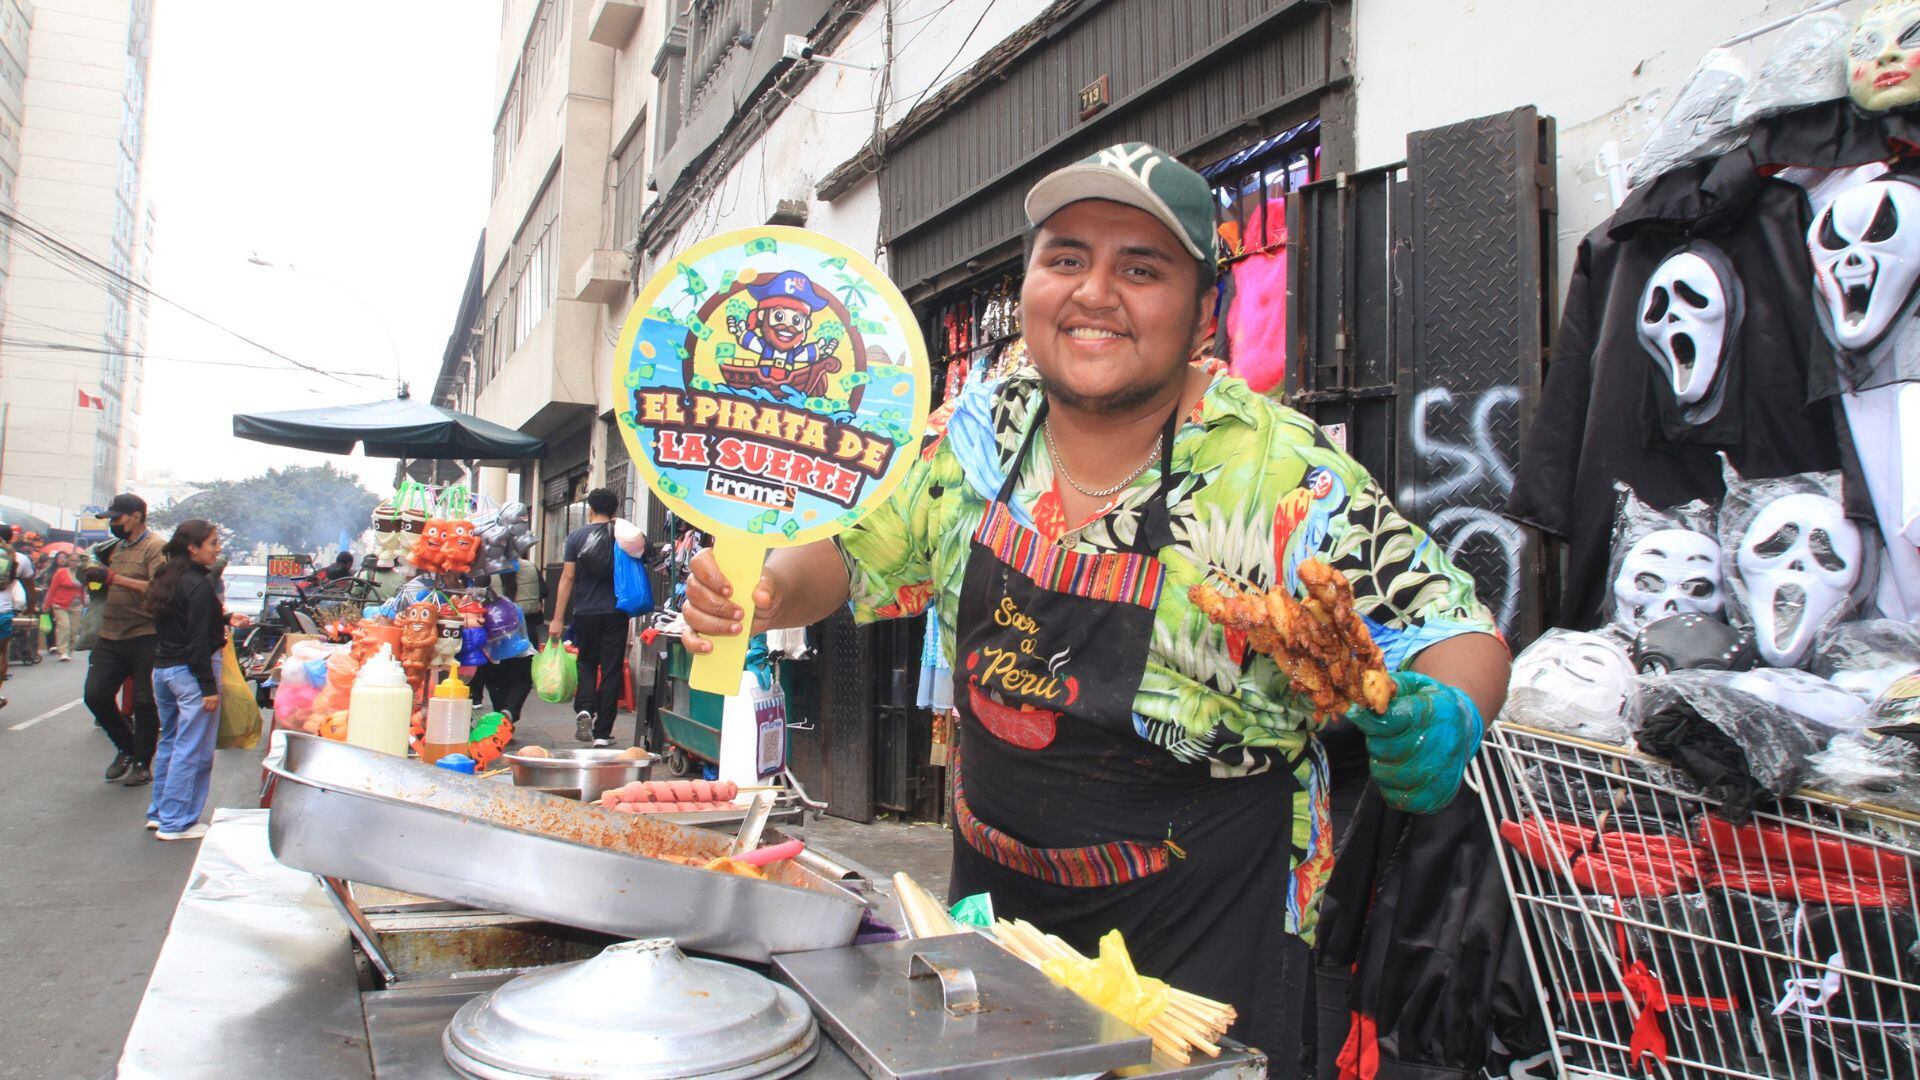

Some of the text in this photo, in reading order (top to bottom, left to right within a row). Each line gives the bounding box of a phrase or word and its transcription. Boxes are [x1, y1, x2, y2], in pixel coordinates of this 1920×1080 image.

[641, 392, 891, 471] EL PIRATA DE
[658, 430, 860, 500] LA SUERTE
[711, 472, 787, 507] trome
[268, 559, 303, 577] USB
